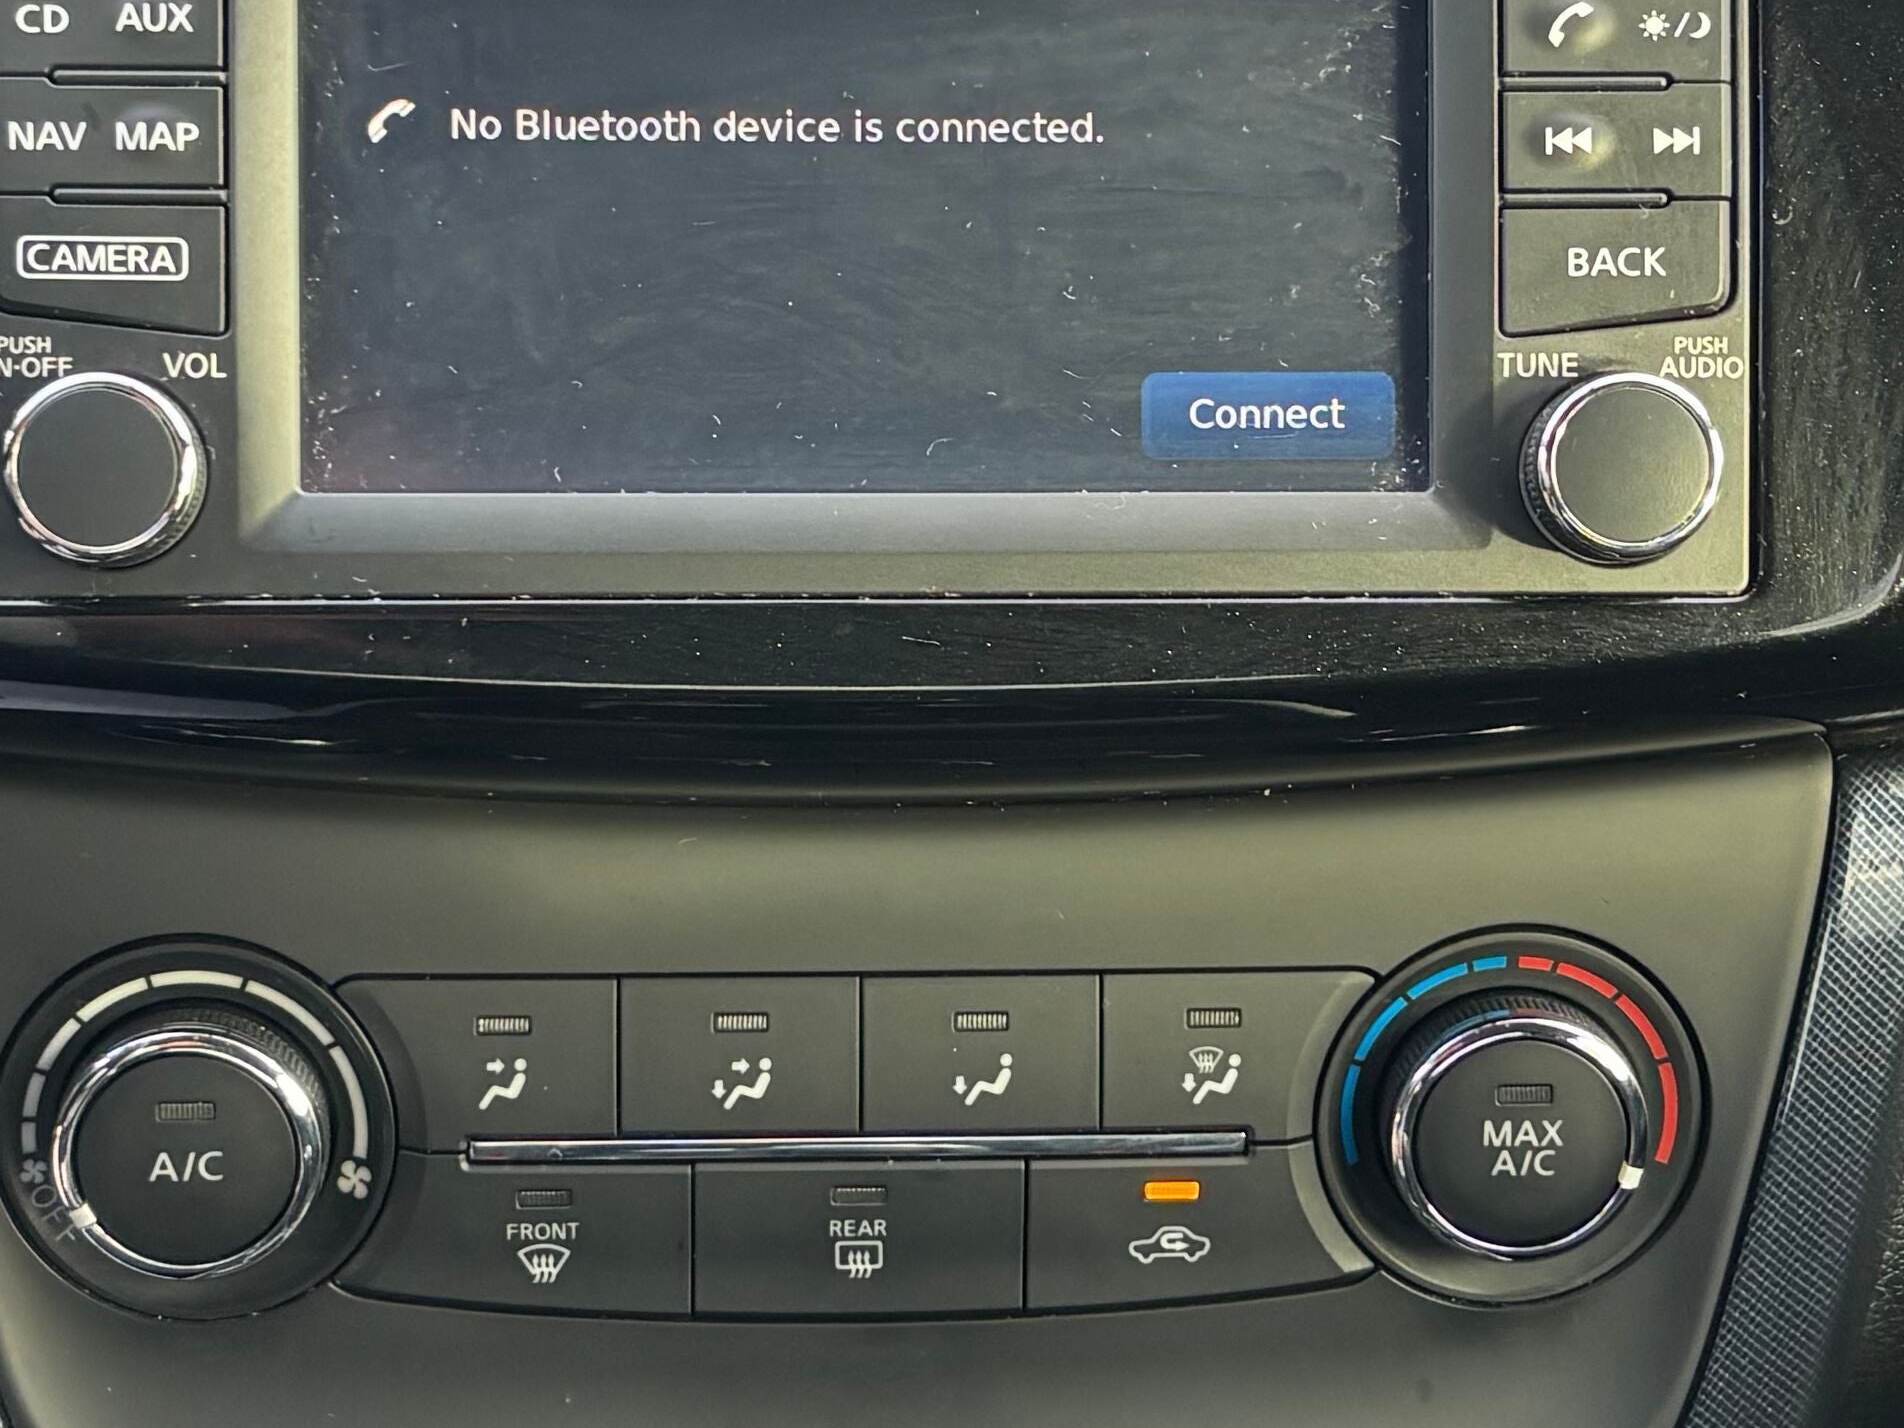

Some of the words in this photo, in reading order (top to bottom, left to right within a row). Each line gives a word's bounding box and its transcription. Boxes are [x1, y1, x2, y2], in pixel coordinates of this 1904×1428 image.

[15, 3, 70, 34] CD
[115, 2, 194, 33] AUX
[7, 120, 87, 151] NAV
[115, 121, 200, 152] MAP
[451, 108, 502, 140] No
[516, 108, 701, 142] Bluetooth
[713, 108, 841, 143] device
[854, 109, 883, 143] is
[896, 111, 1104, 143] connected.
[27, 243, 177, 274] CAMERA
[1567, 246, 1667, 277] BACK
[1674, 335, 1729, 355] PUSH
[162, 351, 228, 379] VOL
[1496, 352, 1579, 378] TUNE
[1659, 356, 1744, 379] AUDIO
[1189, 398, 1346, 429] Connect
[1483, 1119, 1563, 1147] MAX
[149, 1150, 223, 1182] A/C
[1491, 1149, 1556, 1176] A/C
[506, 1222, 579, 1240] FRONT
[829, 1219, 887, 1237] REAR
